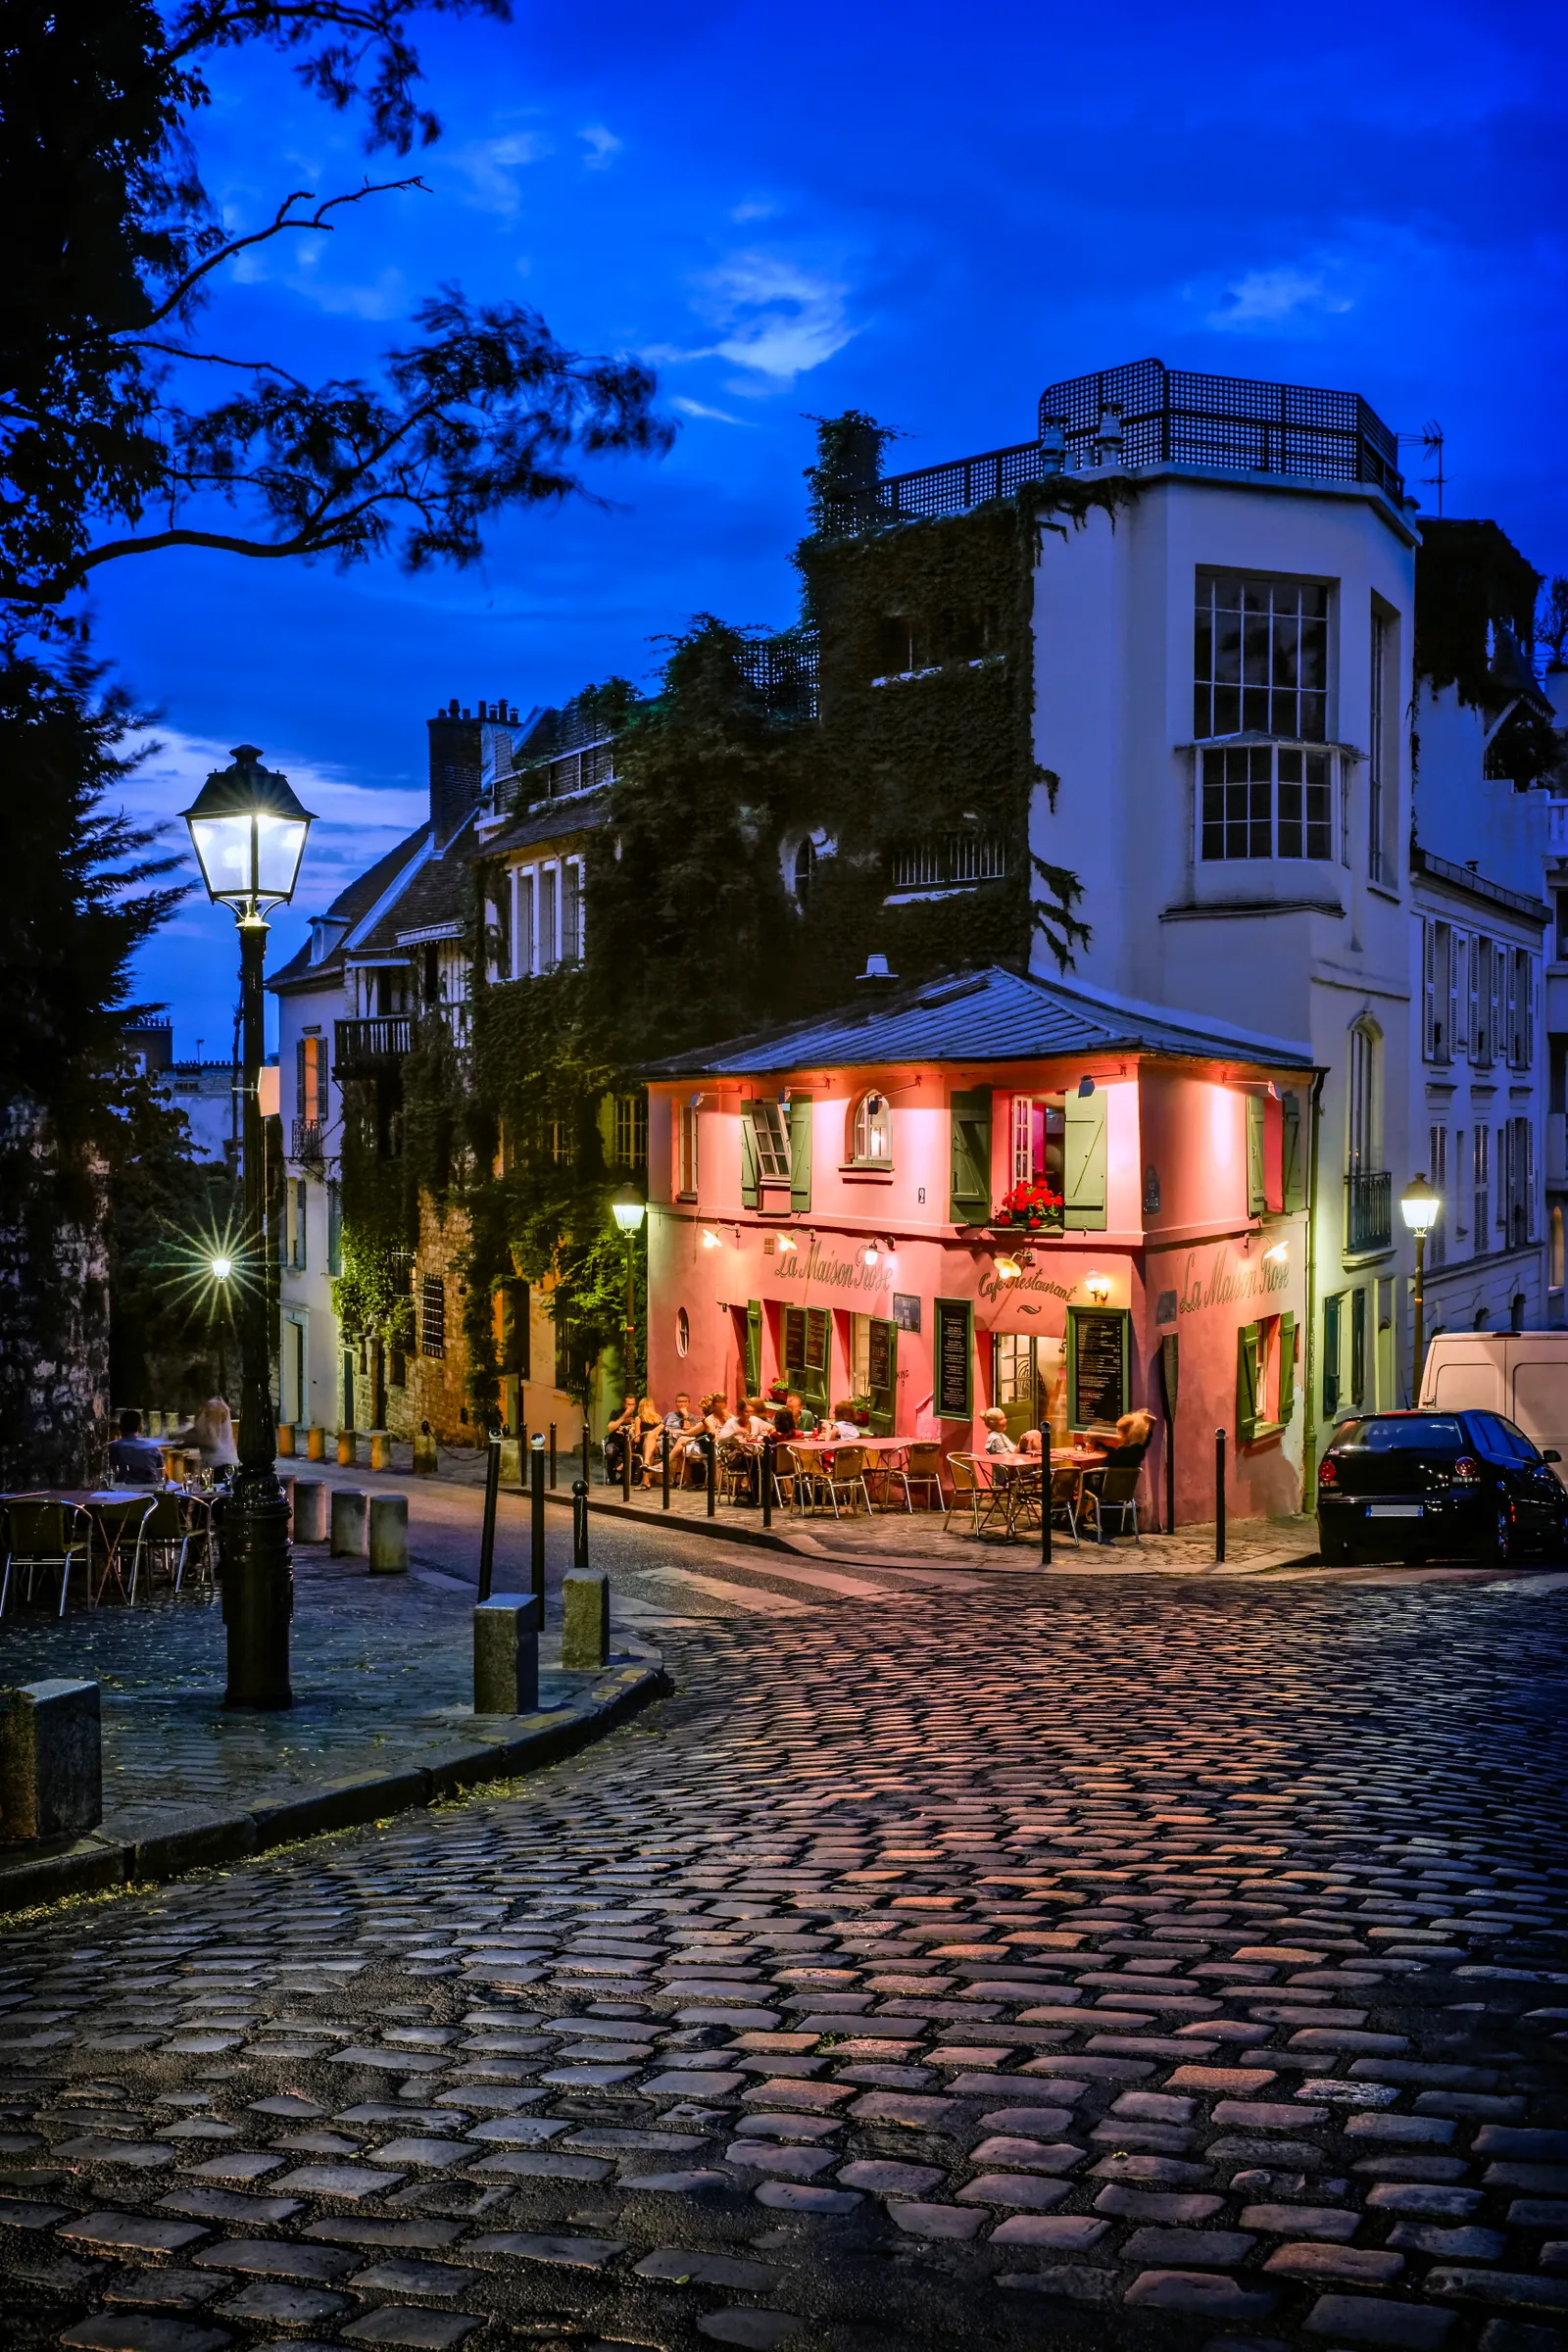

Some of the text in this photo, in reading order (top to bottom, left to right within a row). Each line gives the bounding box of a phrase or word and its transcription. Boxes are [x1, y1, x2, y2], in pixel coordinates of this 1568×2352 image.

[775, 1250, 798, 1278] La
[798, 1240, 854, 1288] Maison
[1179, 1252, 1201, 1313] La
[1203, 1247, 1257, 1308] Maison
[1259, 1249, 1290, 1295] Rose
